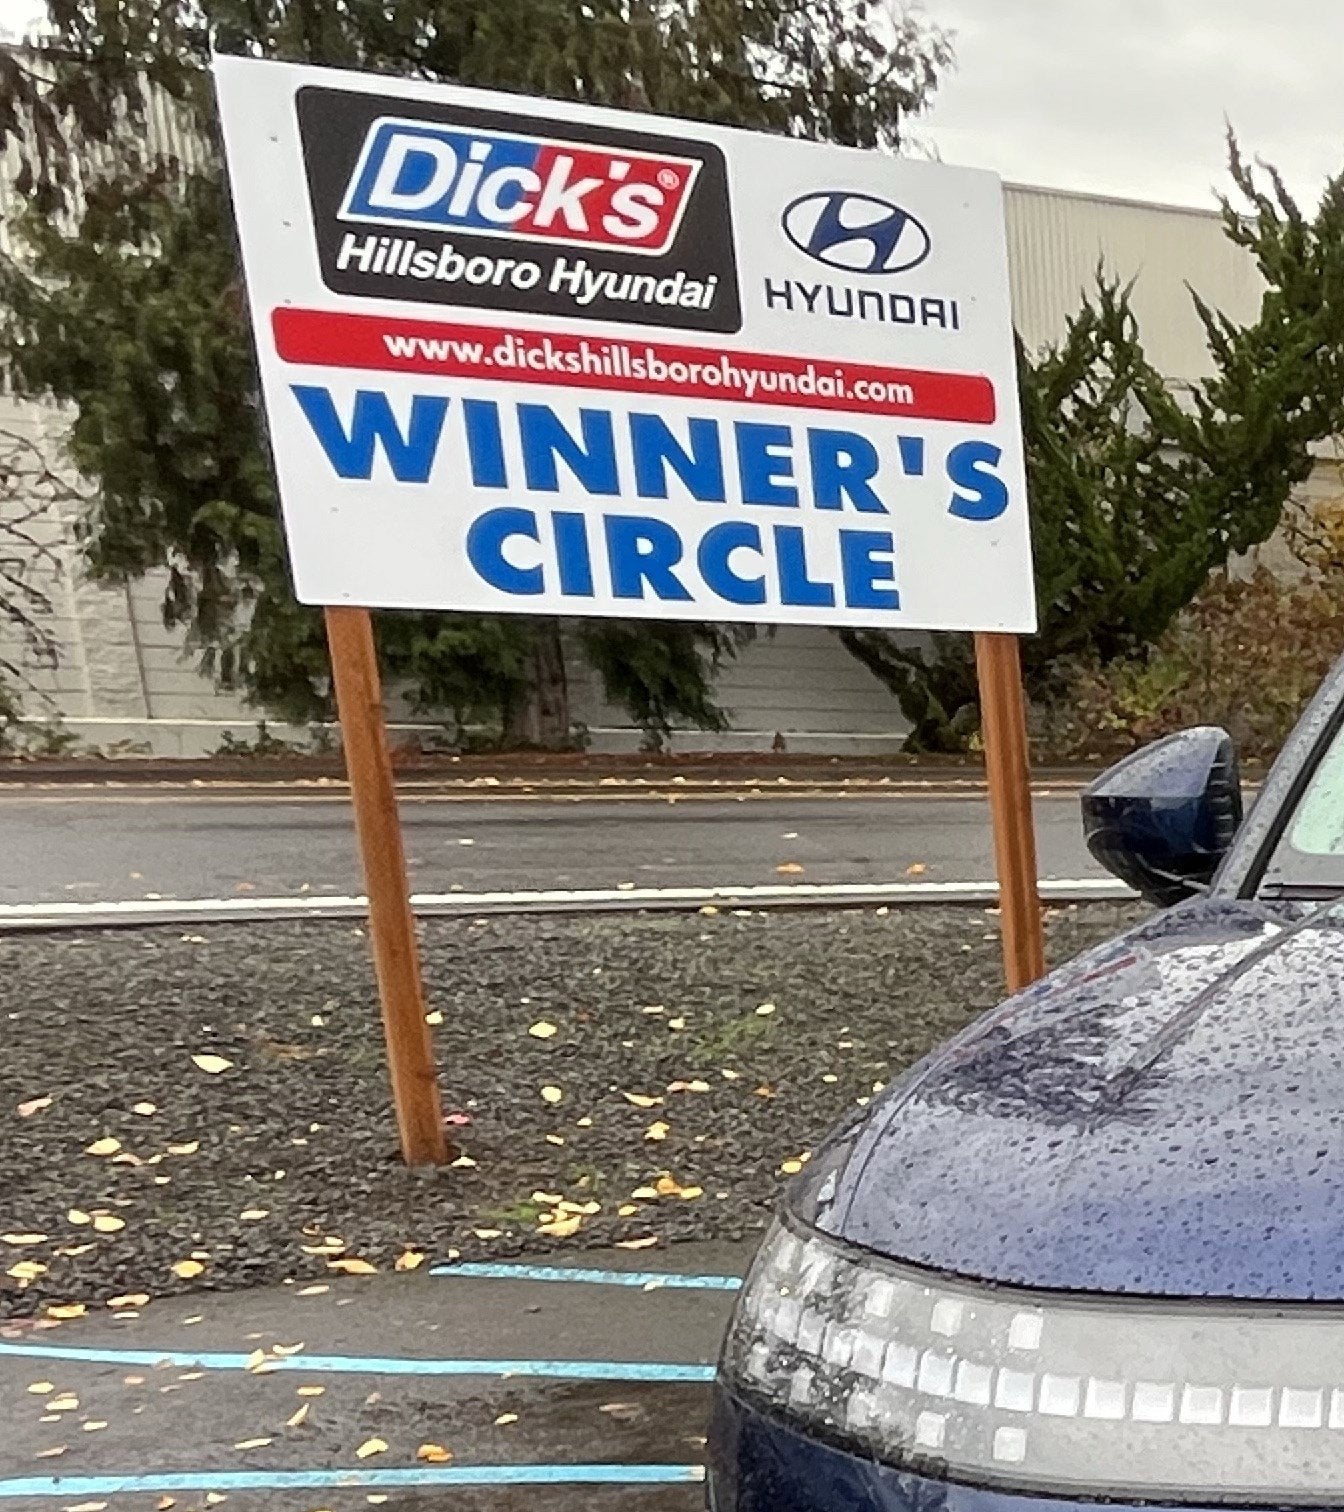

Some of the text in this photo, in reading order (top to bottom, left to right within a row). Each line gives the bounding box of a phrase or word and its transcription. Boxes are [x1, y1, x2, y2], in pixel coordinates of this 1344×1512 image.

[368, 133, 666, 240] Dick's
[336, 232, 720, 310] Hillsboro Hyundai
[764, 277, 960, 331] HYUNDAI
[383, 330, 914, 405] www.dickshillsborohyundai.com
[289, 384, 1010, 522] WINNER'S
[466, 505, 902, 611] CIRCLE
